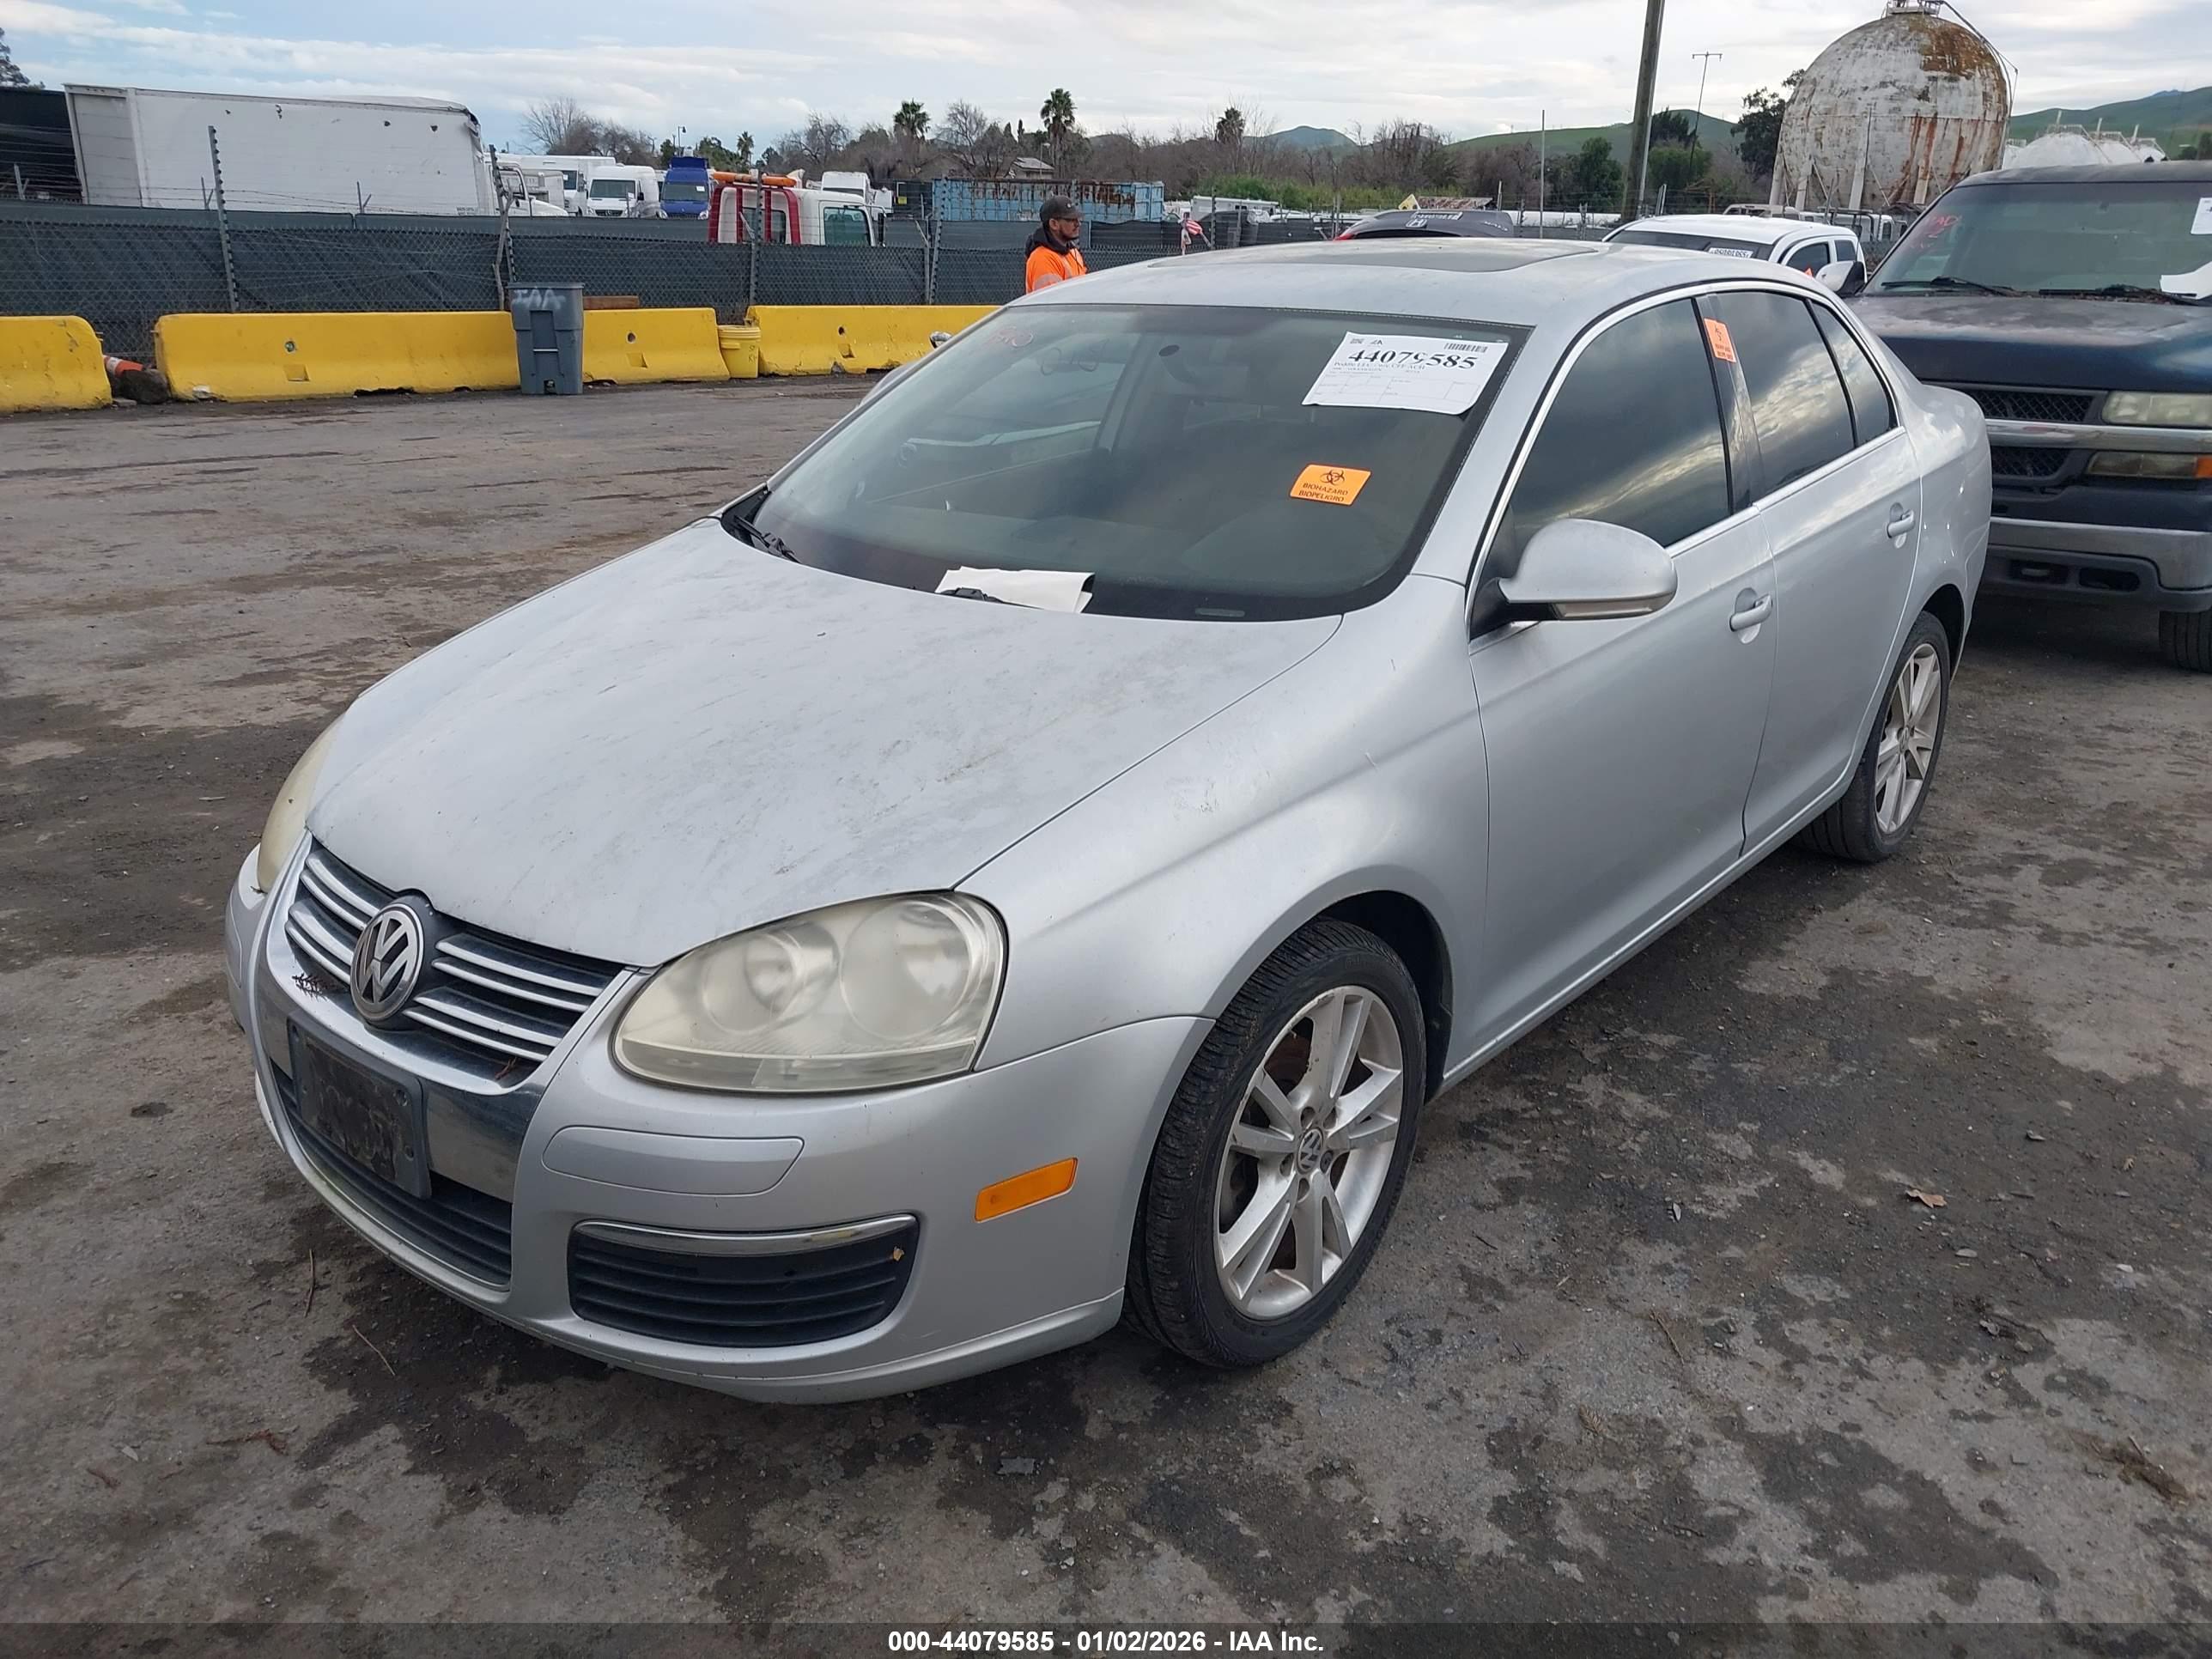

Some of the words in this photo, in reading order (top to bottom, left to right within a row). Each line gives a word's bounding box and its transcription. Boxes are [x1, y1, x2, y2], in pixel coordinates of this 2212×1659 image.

[1348, 349, 1478, 369] 44079585
[1298, 489, 1346, 502] BIOPELIGRO
[1302, 483, 1348, 495] BIOHAZARD
